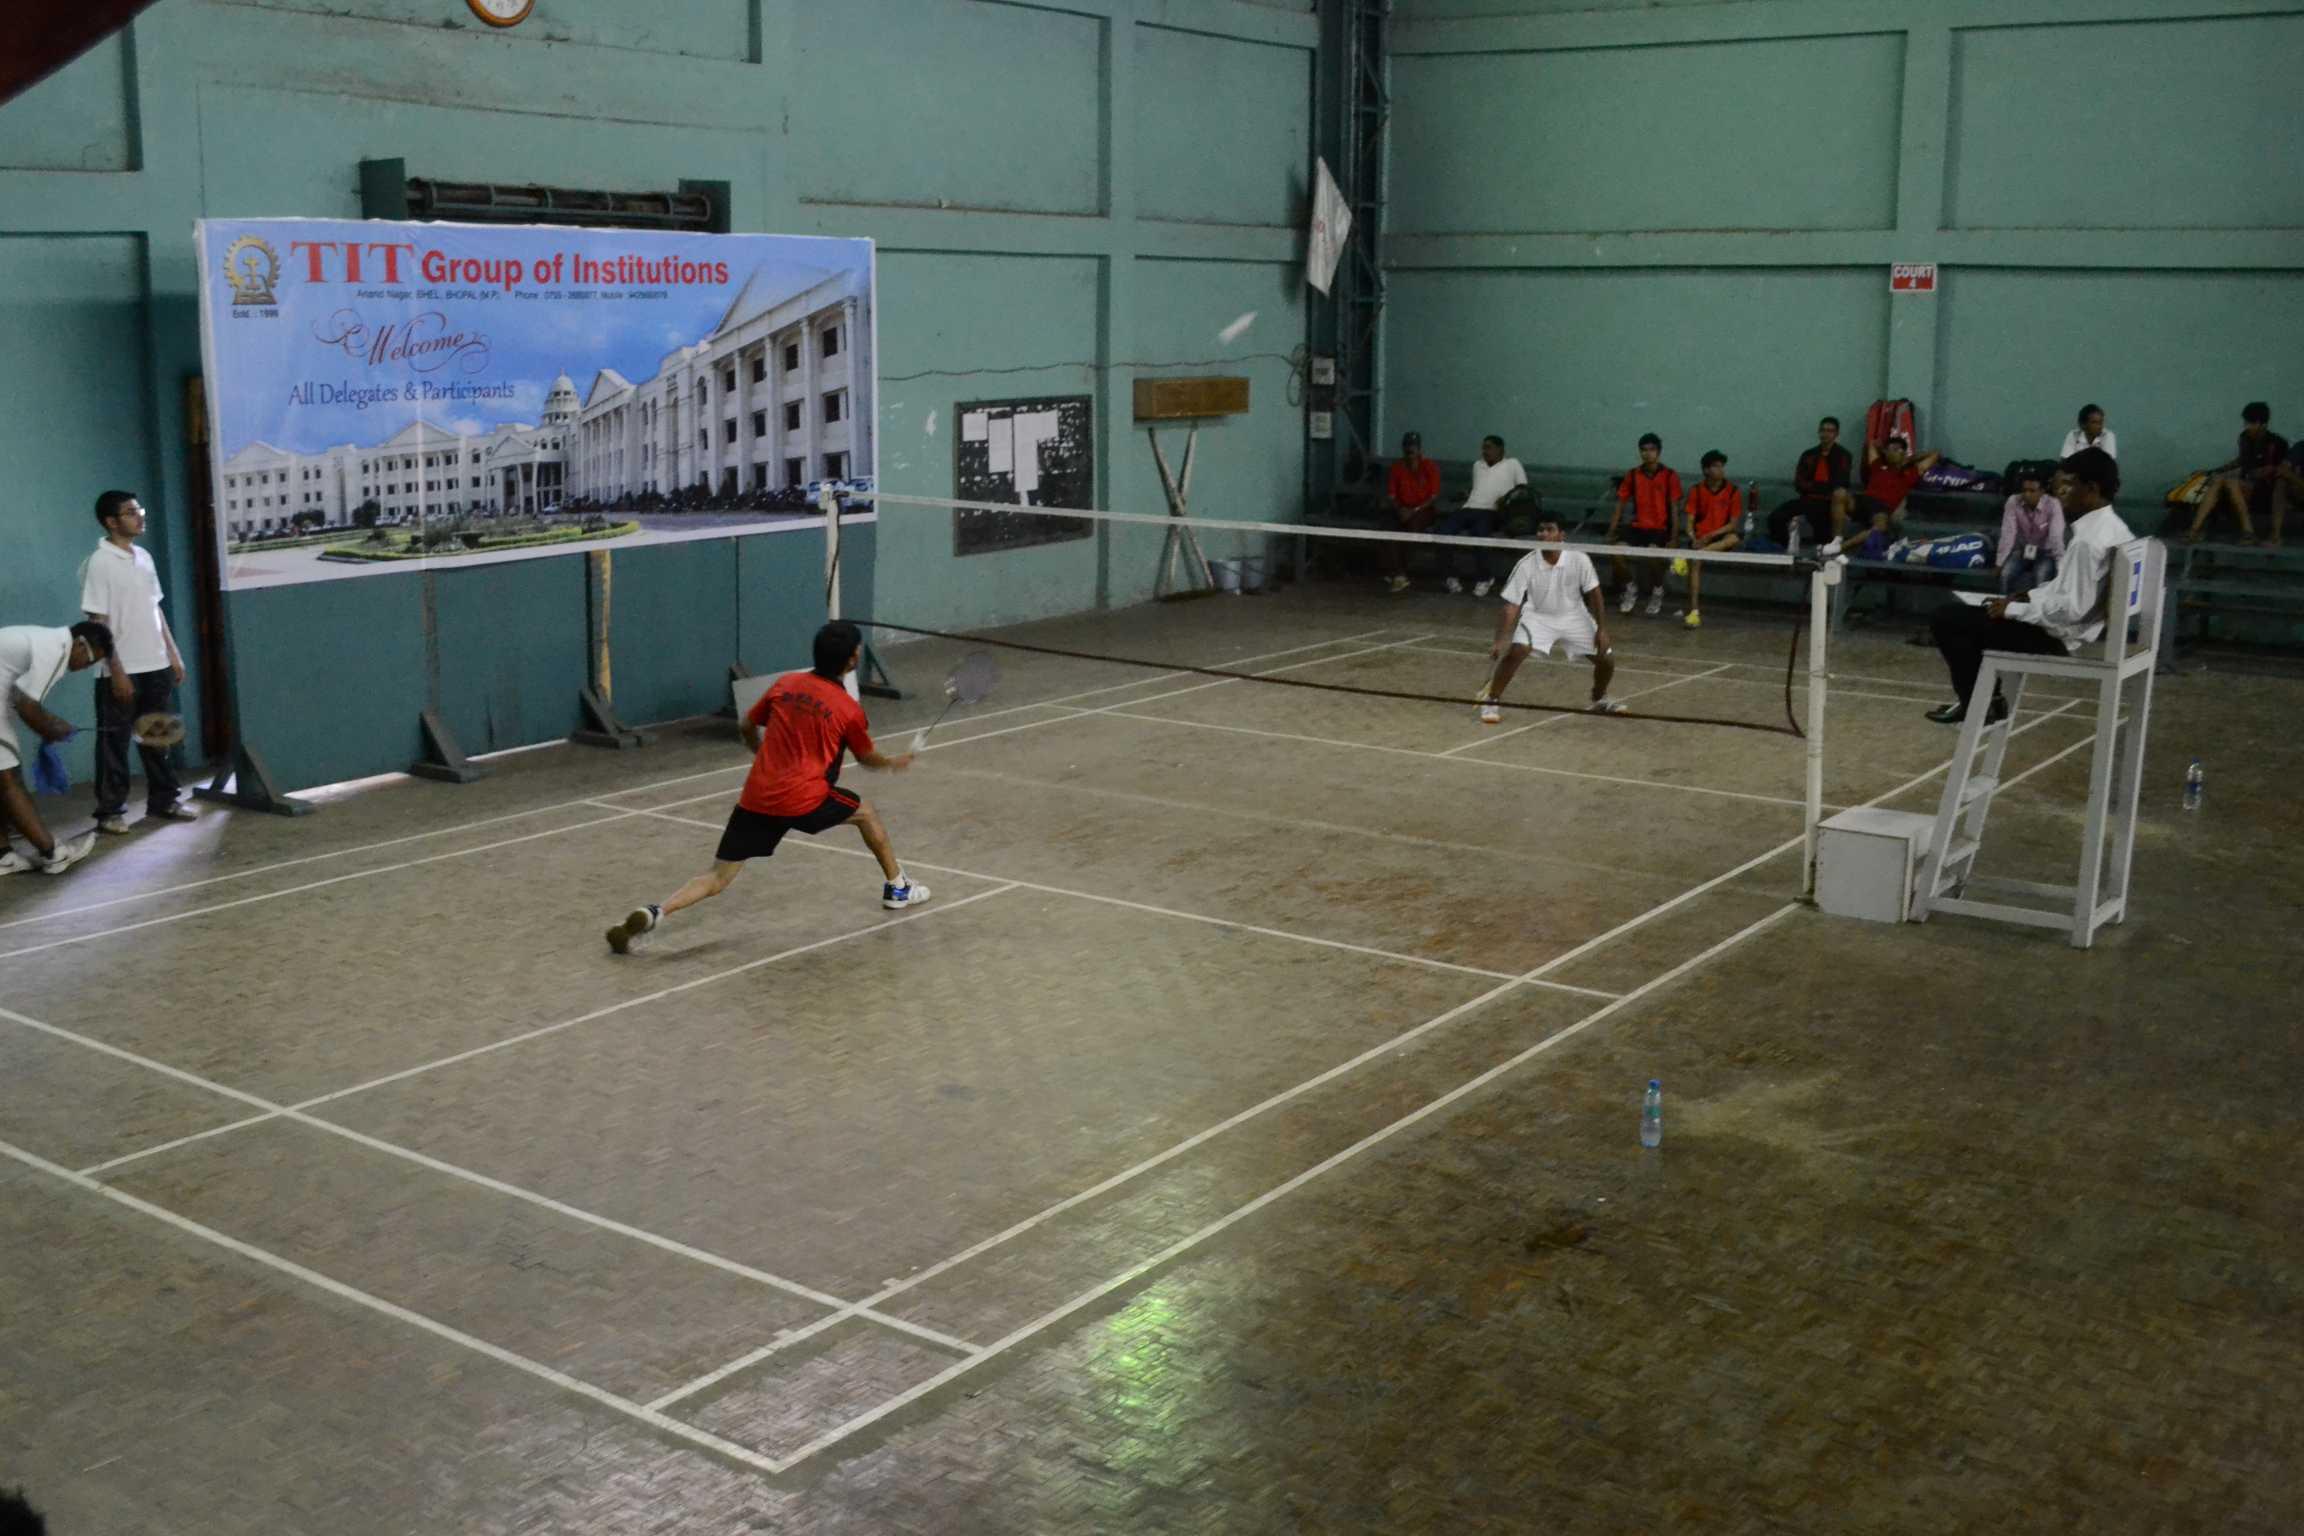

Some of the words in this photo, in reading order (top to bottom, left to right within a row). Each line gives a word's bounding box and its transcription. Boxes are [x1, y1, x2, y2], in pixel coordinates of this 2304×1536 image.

[290, 241, 415, 283] TIT
[422, 250, 522, 290] Group
[533, 253, 564, 285] of
[573, 254, 729, 285] Institutions
[1894, 266, 1932, 278] COURT
[314, 308, 489, 374] Welcome
[288, 382, 315, 406] All
[319, 381, 398, 410] Delegates
[404, 381, 419, 400] &
[422, 379, 515, 405] Participants
